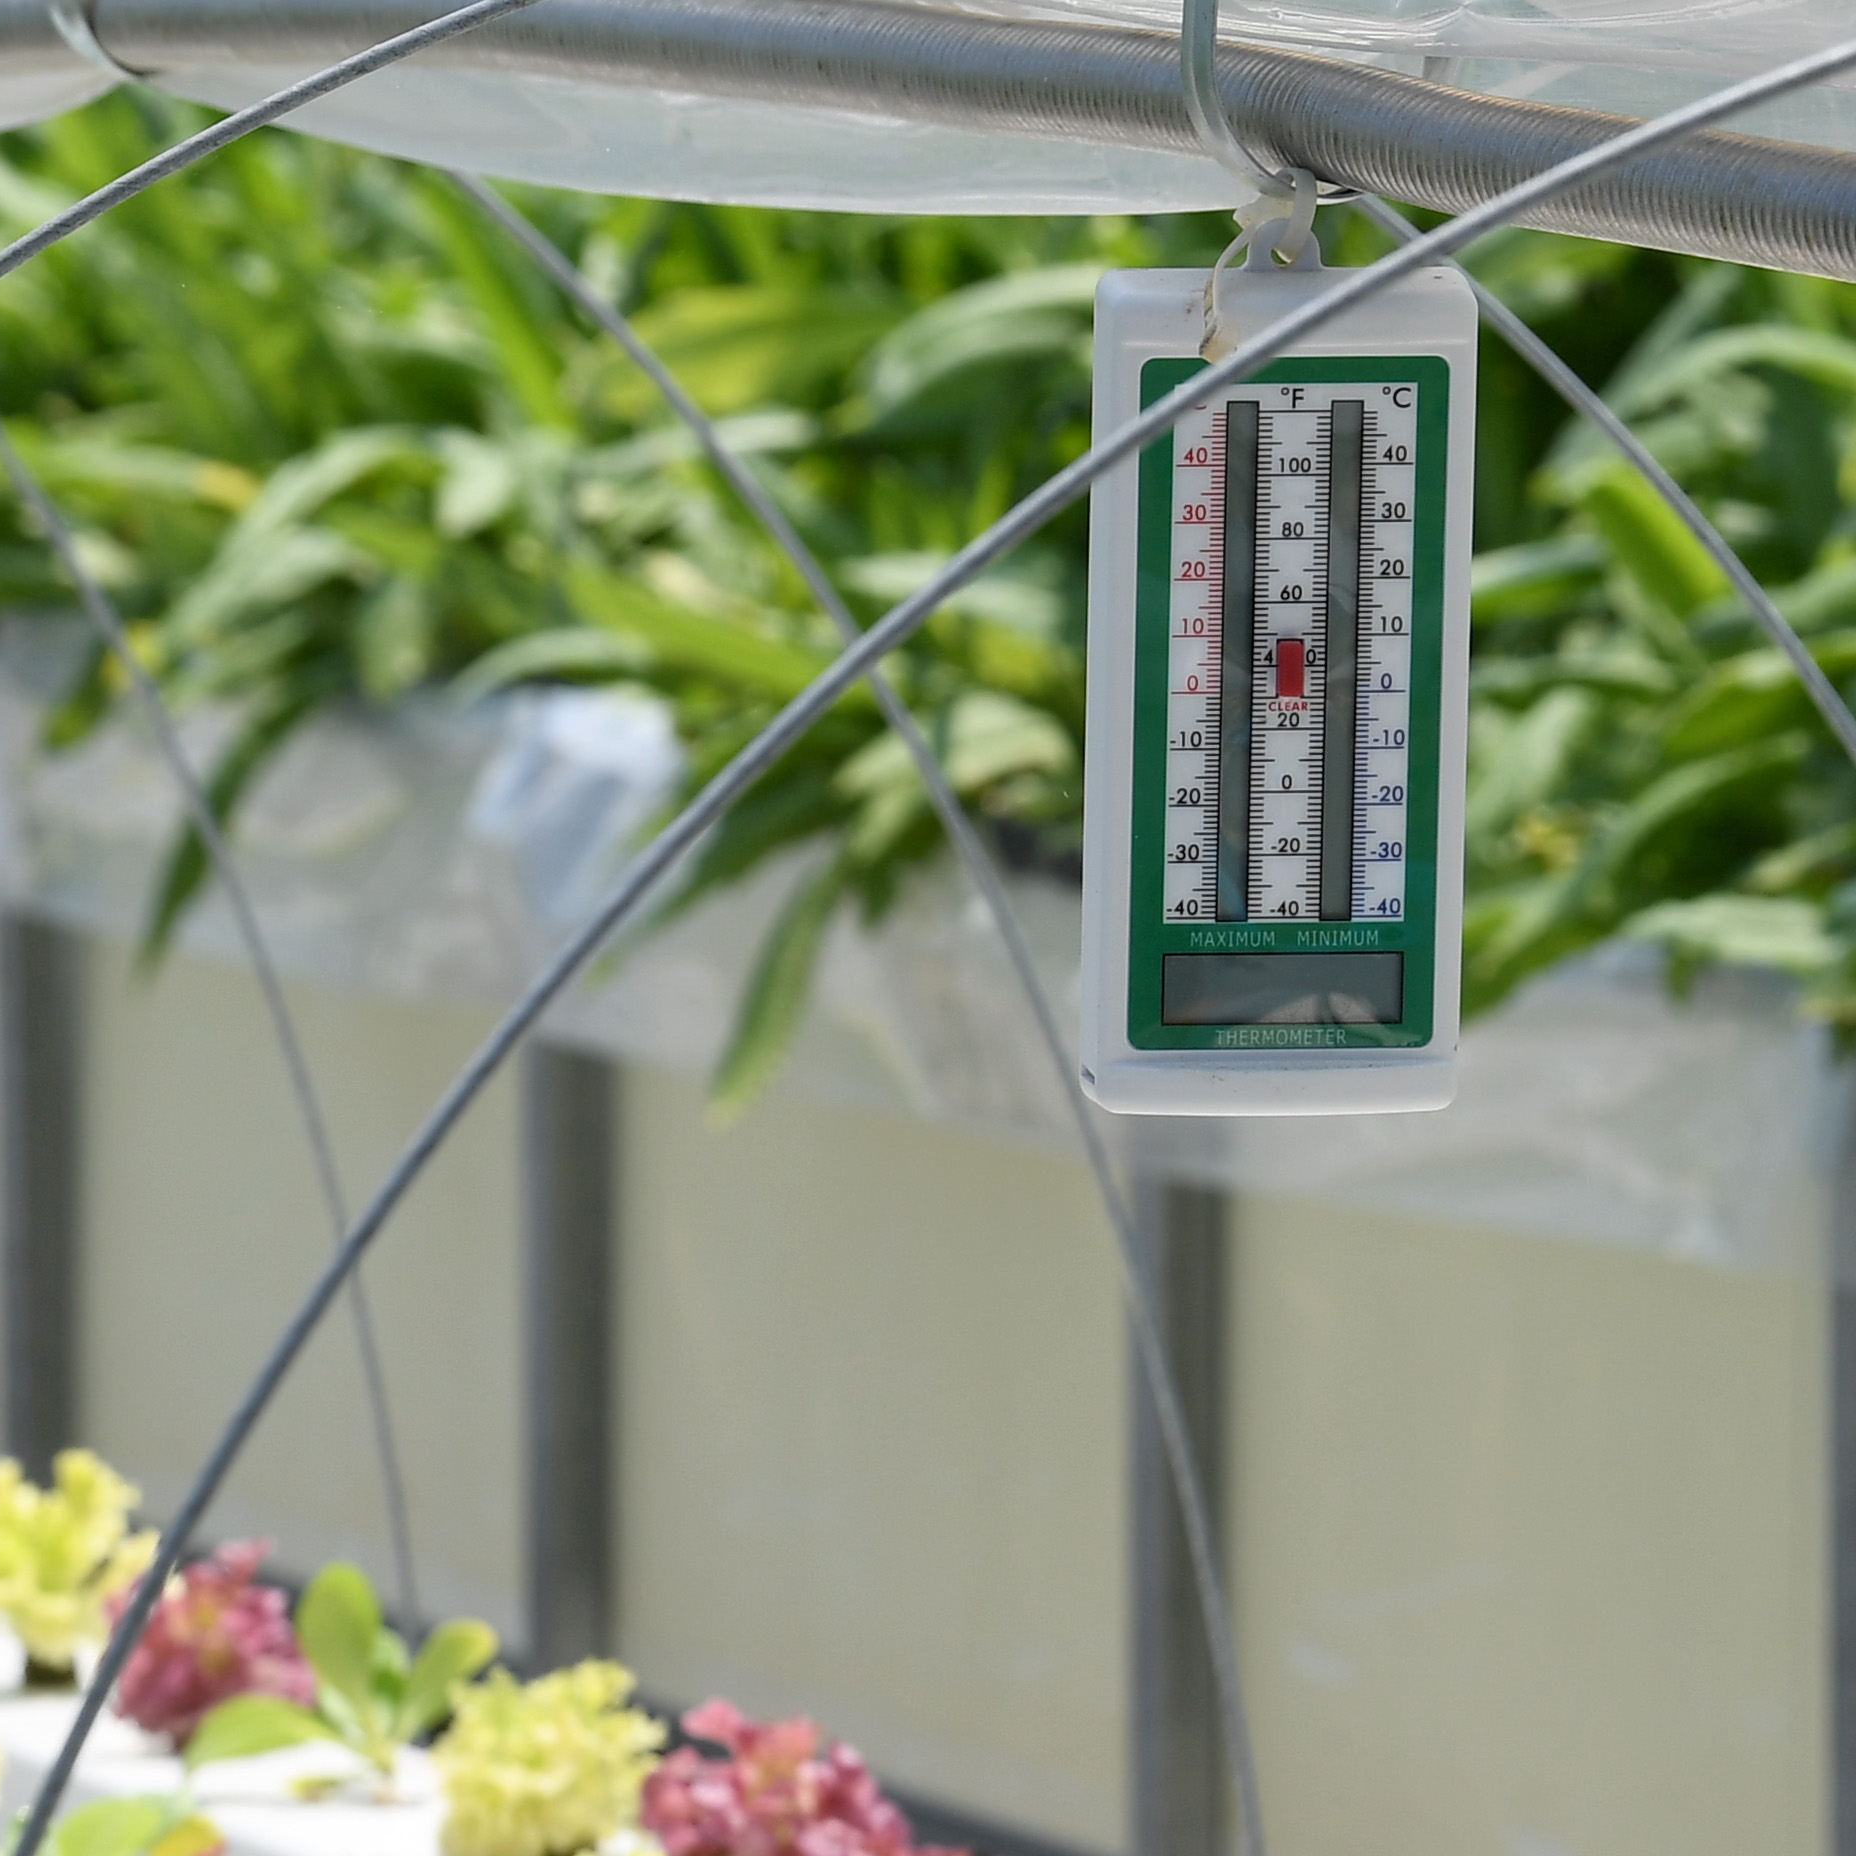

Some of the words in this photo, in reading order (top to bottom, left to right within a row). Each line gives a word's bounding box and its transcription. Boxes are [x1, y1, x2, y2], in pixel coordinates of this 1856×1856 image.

[1280, 387, 1305, 409] °F
[1381, 386, 1412, 409] °C
[1183, 447, 1208, 464] 40
[1382, 445, 1407, 462] 40
[1278, 457, 1312, 473] 100
[1182, 504, 1207, 521] 30
[1381, 502, 1406, 519] 30
[1281, 522, 1304, 537] 80
[1181, 561, 1205, 578] 20
[1379, 559, 1404, 576] 20
[1280, 585, 1303, 600] 60
[1181, 618, 1204, 634] 10
[1380, 616, 1403, 633] 10
[1187, 675, 1199, 691] 0
[1380, 673, 1392, 689] 0
[1268, 701, 1308, 712] CLEAR
[1277, 712, 1300, 728] 20
[1169, 731, 1202, 748] -10
[1373, 729, 1405, 746] -10
[1281, 774, 1292, 790] 0
[1168, 788, 1201, 804] -20
[1371, 785, 1404, 802] -20
[1167, 844, 1200, 861] -30
[1271, 837, 1301, 853] -20
[1370, 842, 1402, 858] -30
[1166, 899, 1199, 916] -40
[1269, 901, 1300, 916] -40
[1369, 898, 1401, 915] -40
[1190, 931, 1276, 948] MAXIMUM
[1296, 930, 1379, 947] MINIMUM
[1215, 1028, 1347, 1046] THERMOMETER
